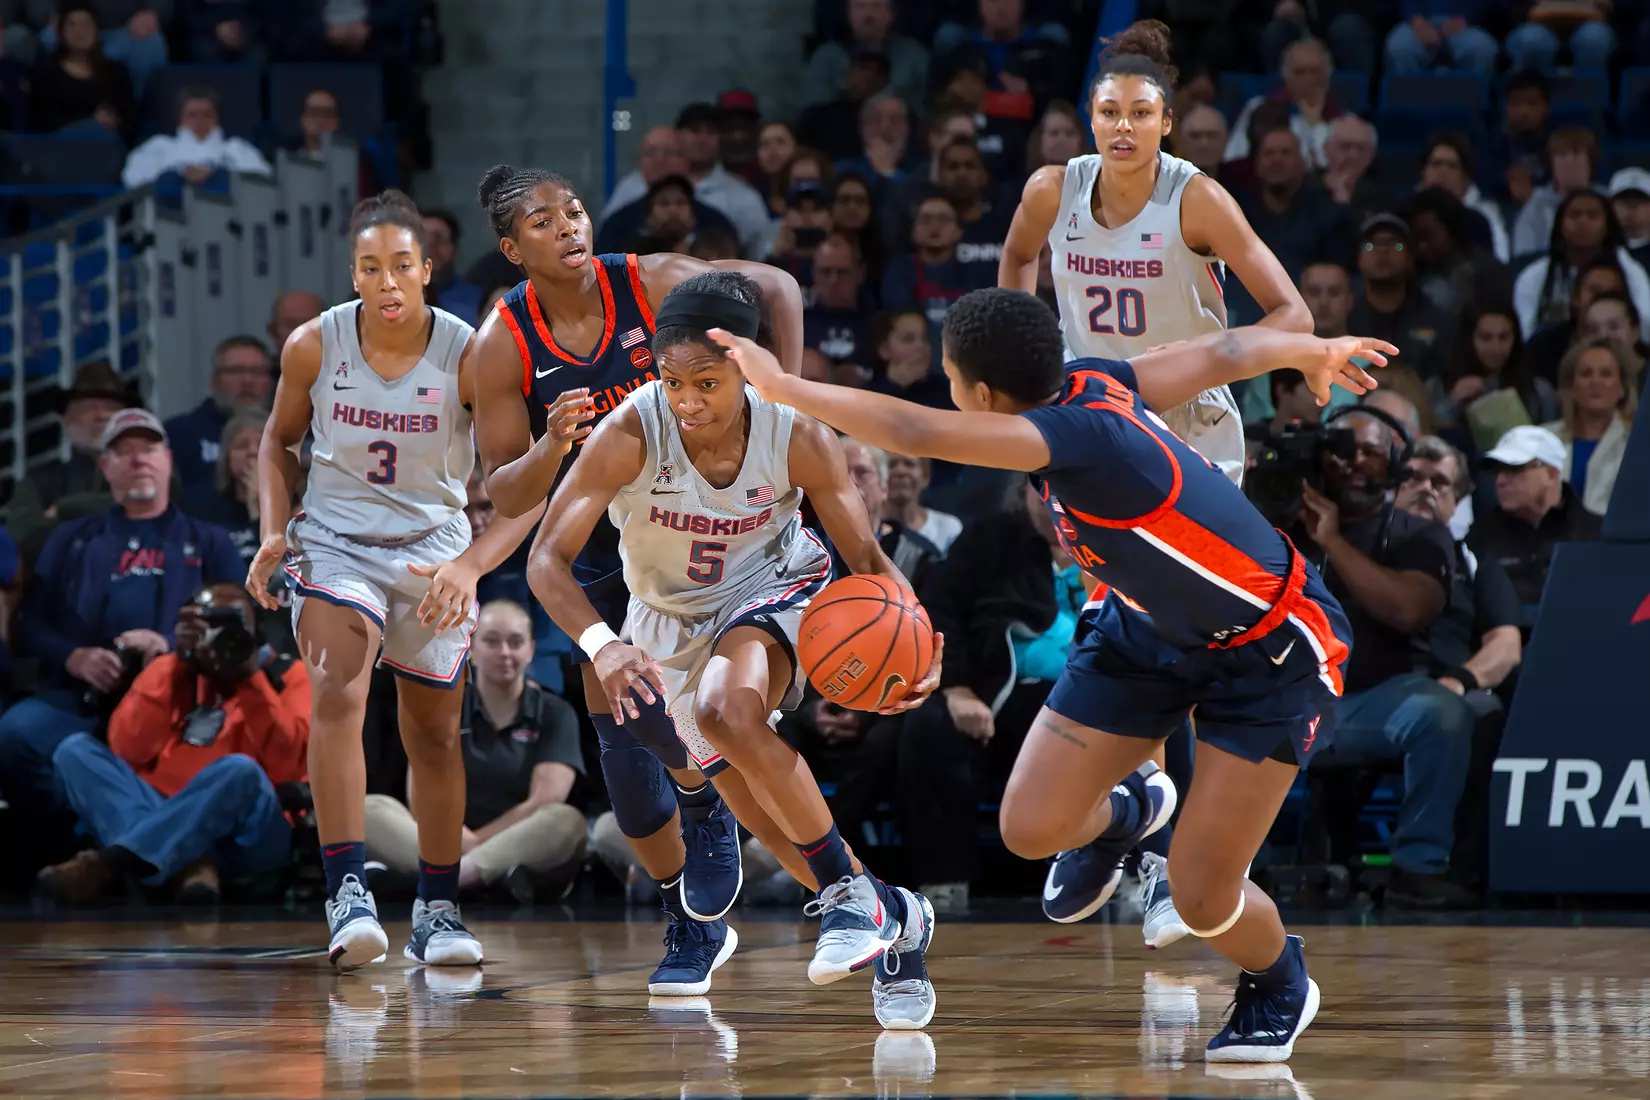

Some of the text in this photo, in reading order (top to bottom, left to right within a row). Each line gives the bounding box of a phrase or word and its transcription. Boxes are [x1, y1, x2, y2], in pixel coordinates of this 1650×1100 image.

[1066, 252, 1163, 278] HUSKIES
[1085, 285, 1147, 337] 20
[332, 402, 439, 434] HUSKIES
[366, 440, 397, 485] 3
[687, 540, 728, 585] 5
[823, 656, 868, 698] ELITE
[1492, 757, 1650, 829] TRA
